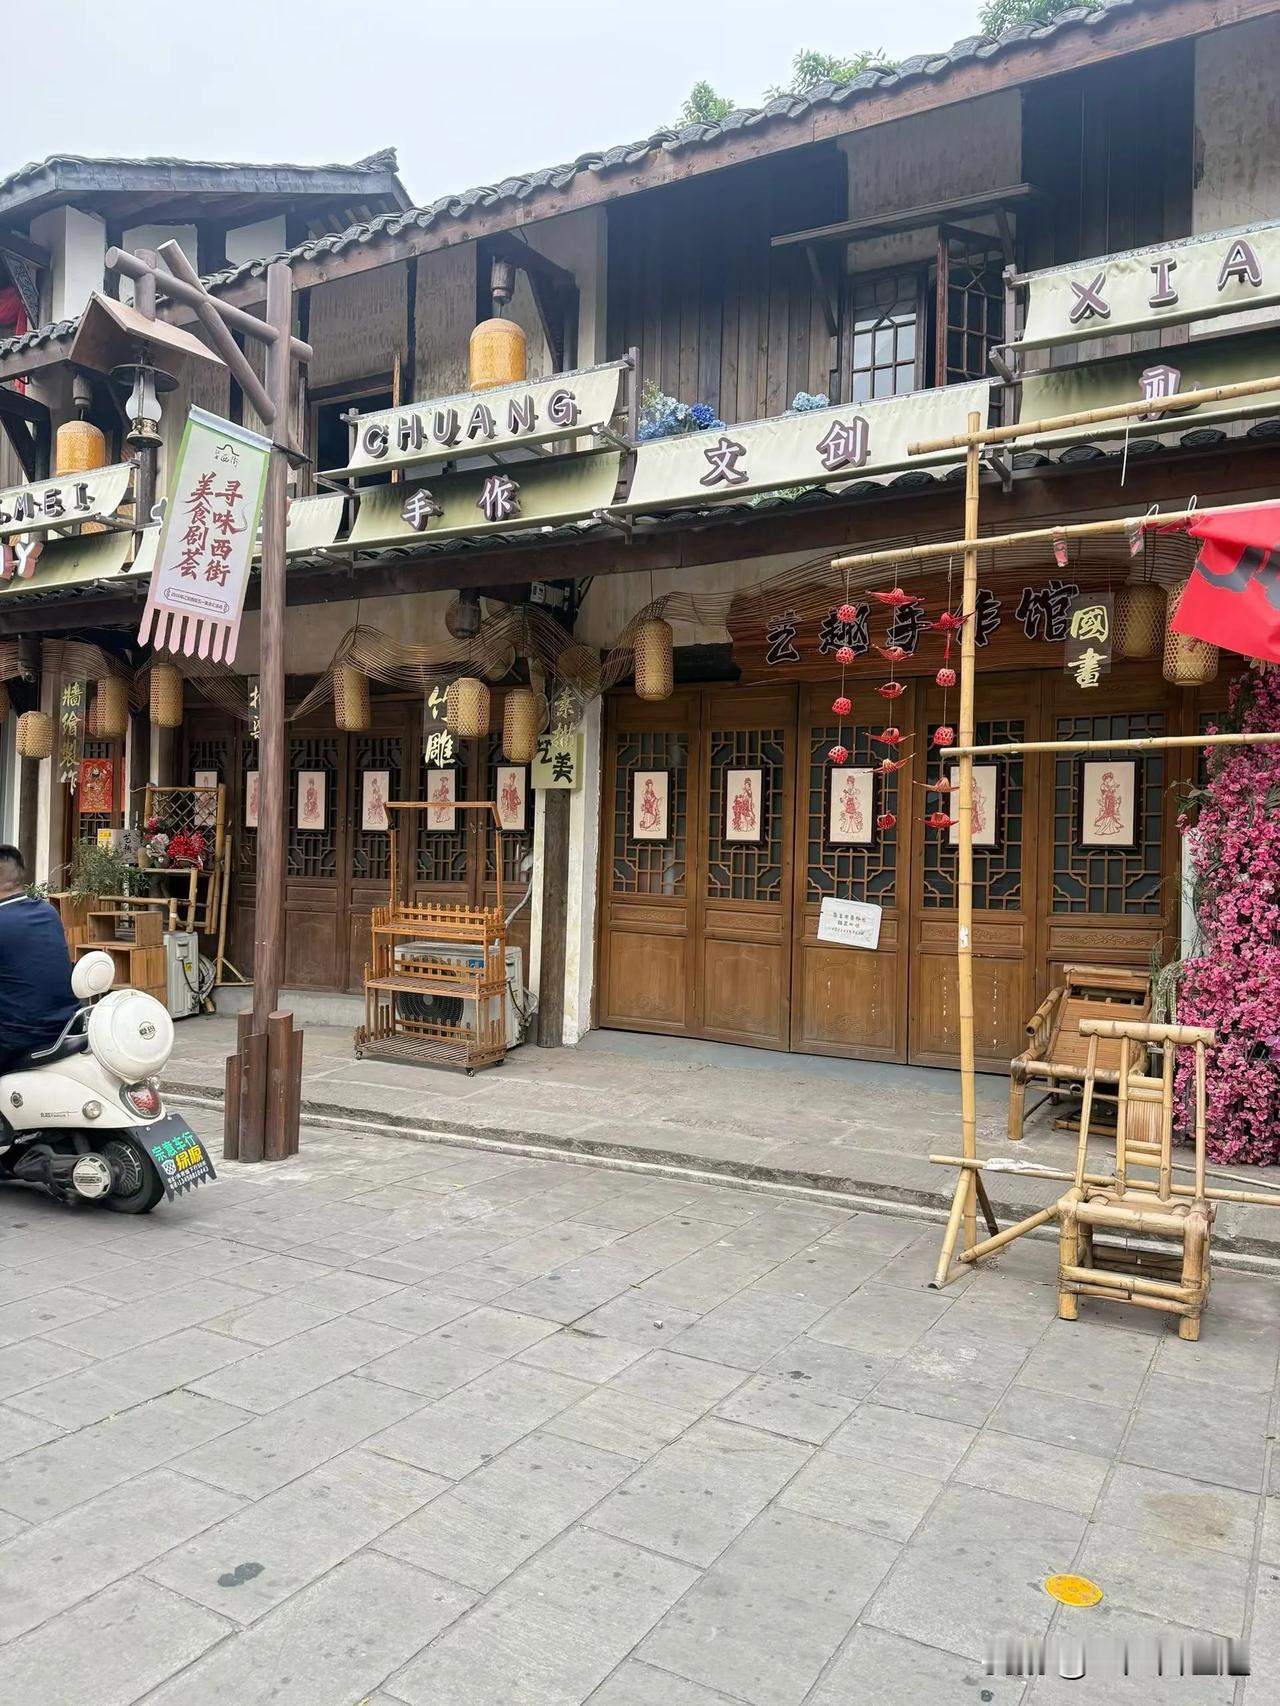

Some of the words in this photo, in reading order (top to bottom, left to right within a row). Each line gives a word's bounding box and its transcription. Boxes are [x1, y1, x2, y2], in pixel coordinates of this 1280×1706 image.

[1069, 240, 1262, 324] XIA
[363, 389, 580, 459] CHUANG
[700, 416, 871, 486] 文创
[170, 472, 217, 581] 美食剧荟
[204, 480, 248, 587] 寻味西街
[401, 474, 520, 531] 手作
[1068, 605, 1109, 689] 國畫
